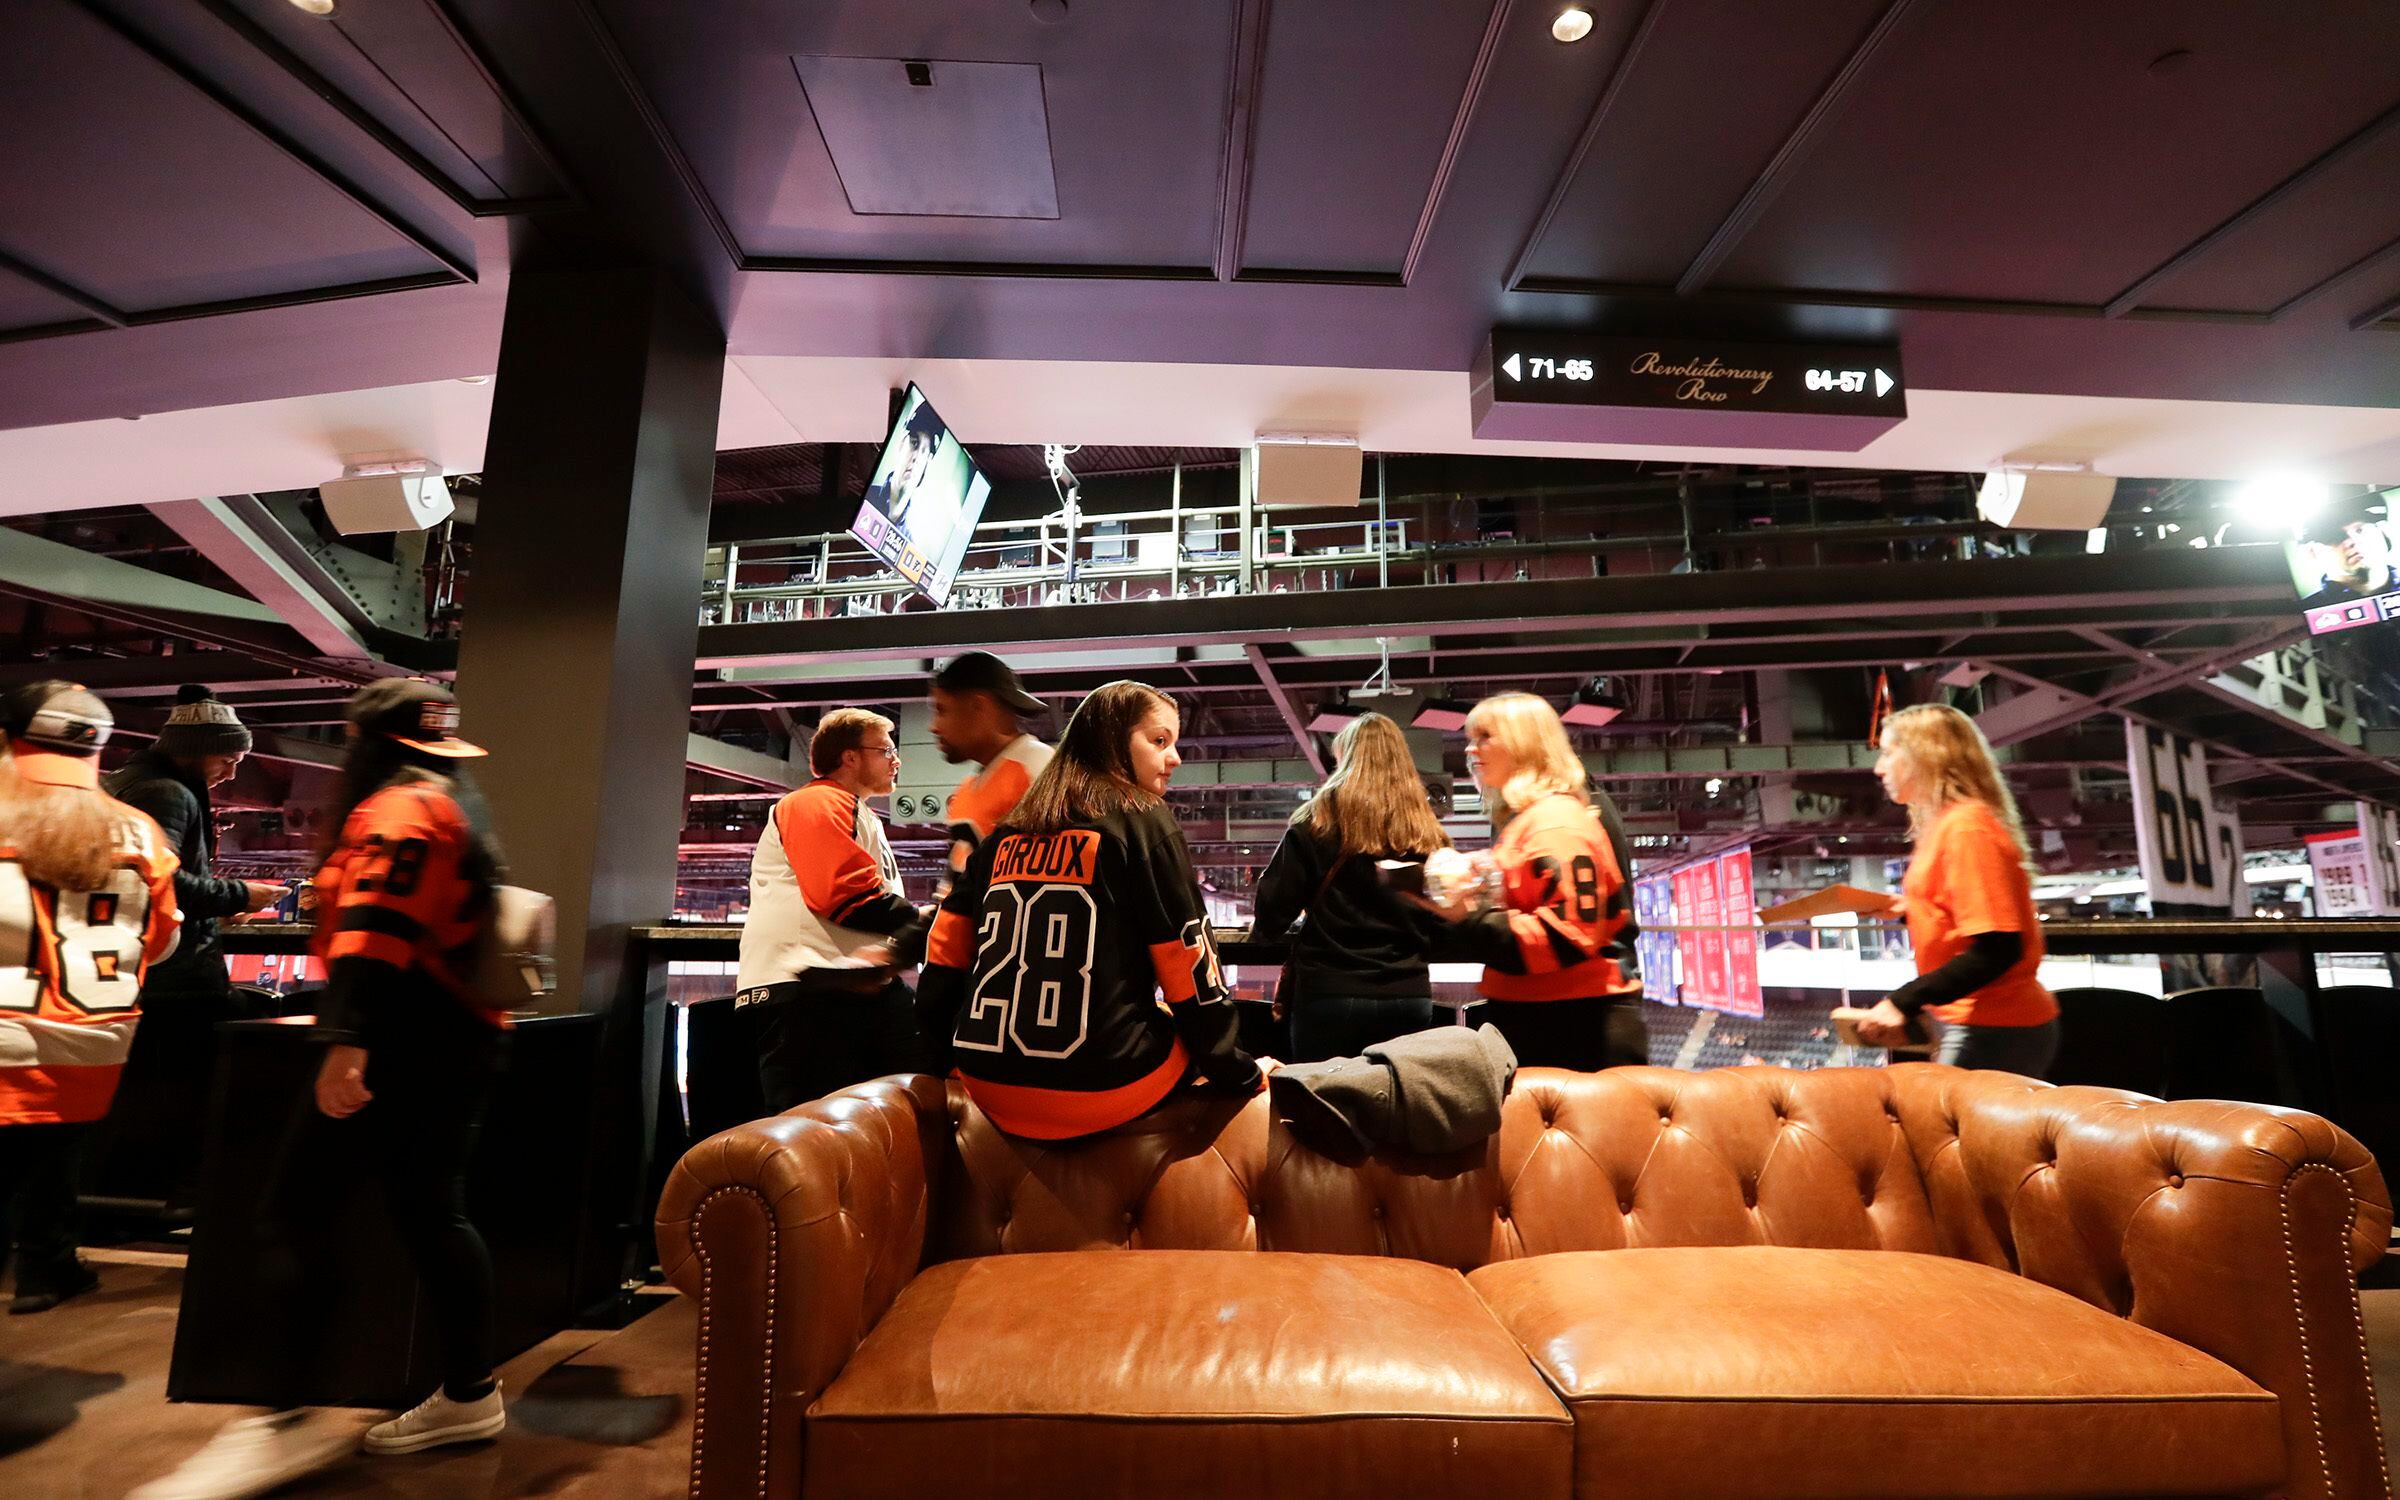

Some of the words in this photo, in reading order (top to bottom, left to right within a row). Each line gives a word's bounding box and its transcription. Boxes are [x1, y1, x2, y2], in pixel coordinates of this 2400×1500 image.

[1528, 357, 1594, 381] 71-65
[1630, 352, 1774, 394] Revolutionary
[1805, 368, 1867, 393] 64-57
[1675, 378, 1728, 402] Row
[993, 835, 1089, 878] GIROUX
[953, 883, 1097, 1060] 28
